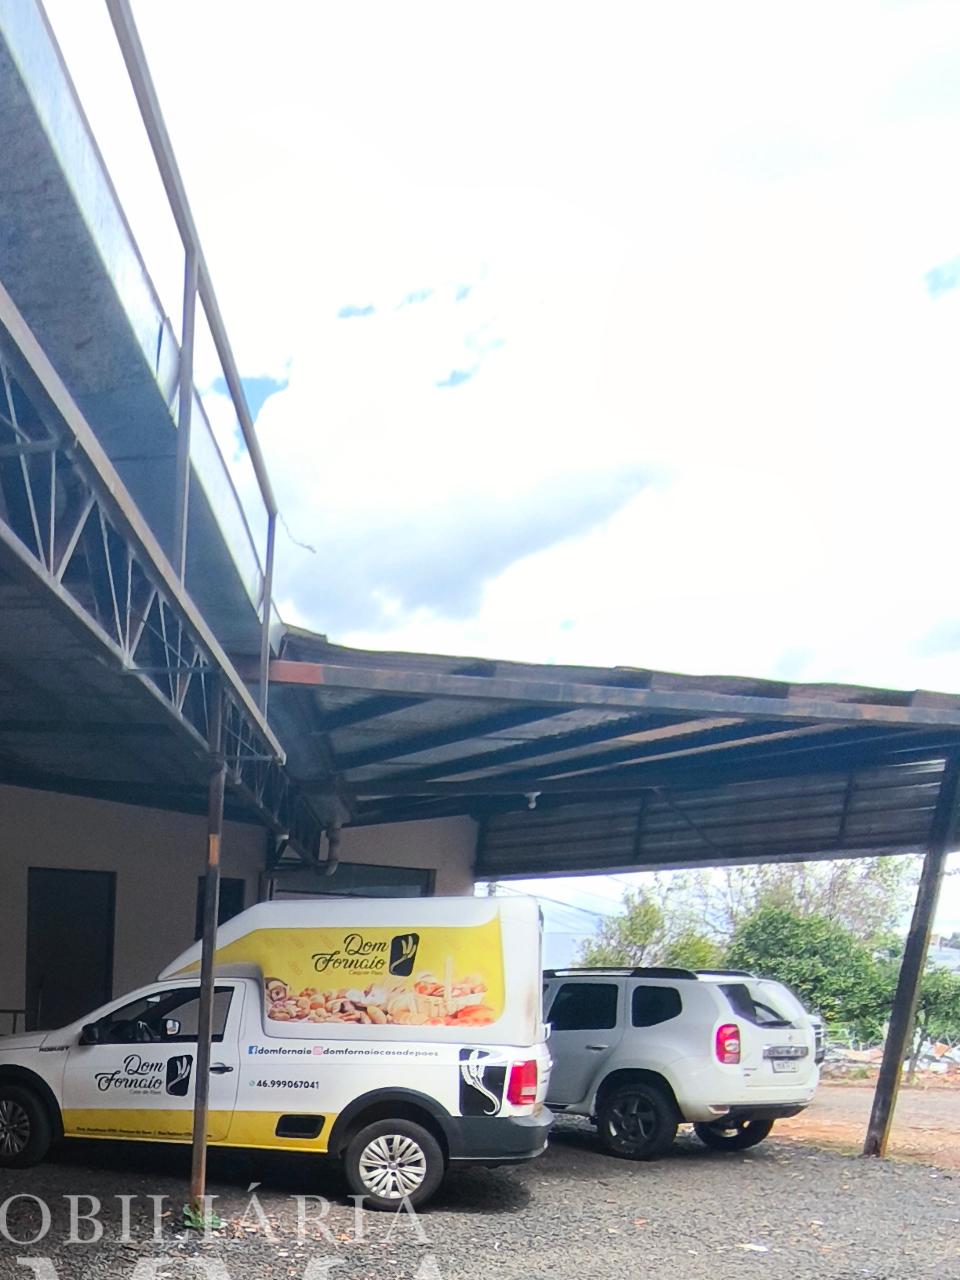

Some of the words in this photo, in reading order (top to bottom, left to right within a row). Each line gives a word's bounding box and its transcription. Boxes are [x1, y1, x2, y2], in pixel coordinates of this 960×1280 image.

[343, 933, 388, 955] Dom
[311, 951, 386, 972] Fornaio
[258, 1047, 312, 1055] domfornaio
[123, 1054, 165, 1075] Dom
[94, 1070, 163, 1091] Fornaio
[256, 1079, 319, 1089] 46.999067041
